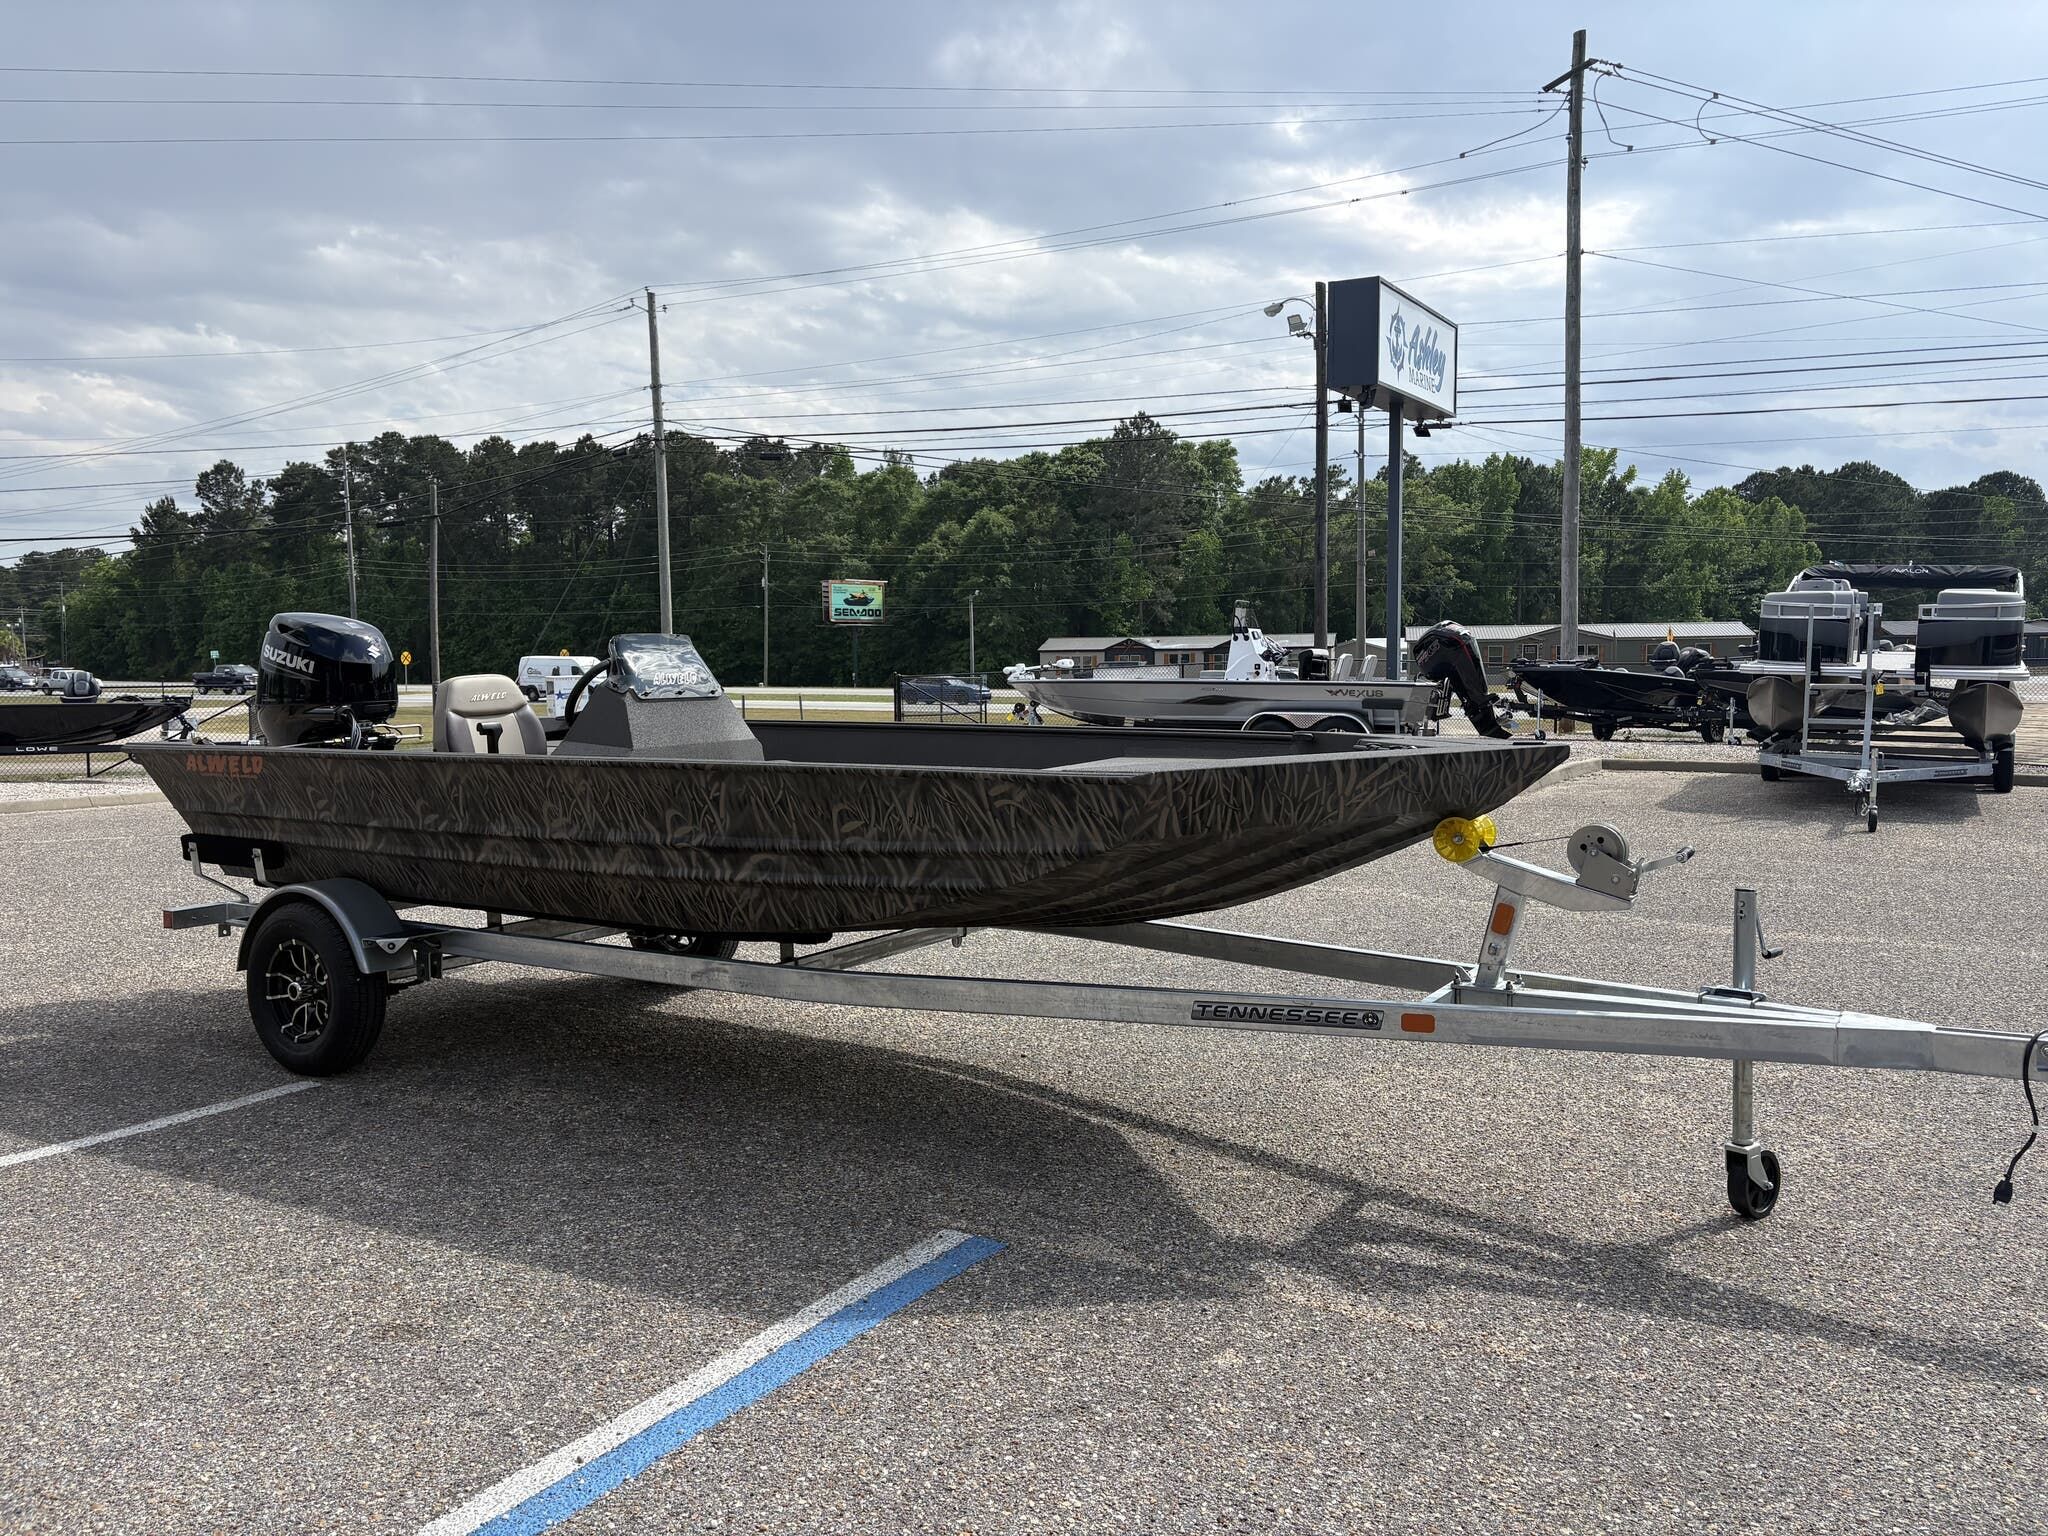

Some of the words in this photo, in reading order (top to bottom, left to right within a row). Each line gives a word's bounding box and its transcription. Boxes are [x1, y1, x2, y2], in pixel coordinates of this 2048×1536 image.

[1408, 324, 1446, 392] Ashley
[1409, 366, 1435, 394] MARINE
[263, 644, 315, 674] SUZUKI
[653, 671, 697, 686] ALWELD
[1339, 688, 1384, 698] VEXUS
[185, 753, 264, 776] ALWELD
[1196, 1003, 1358, 1025] TENNESSEE
